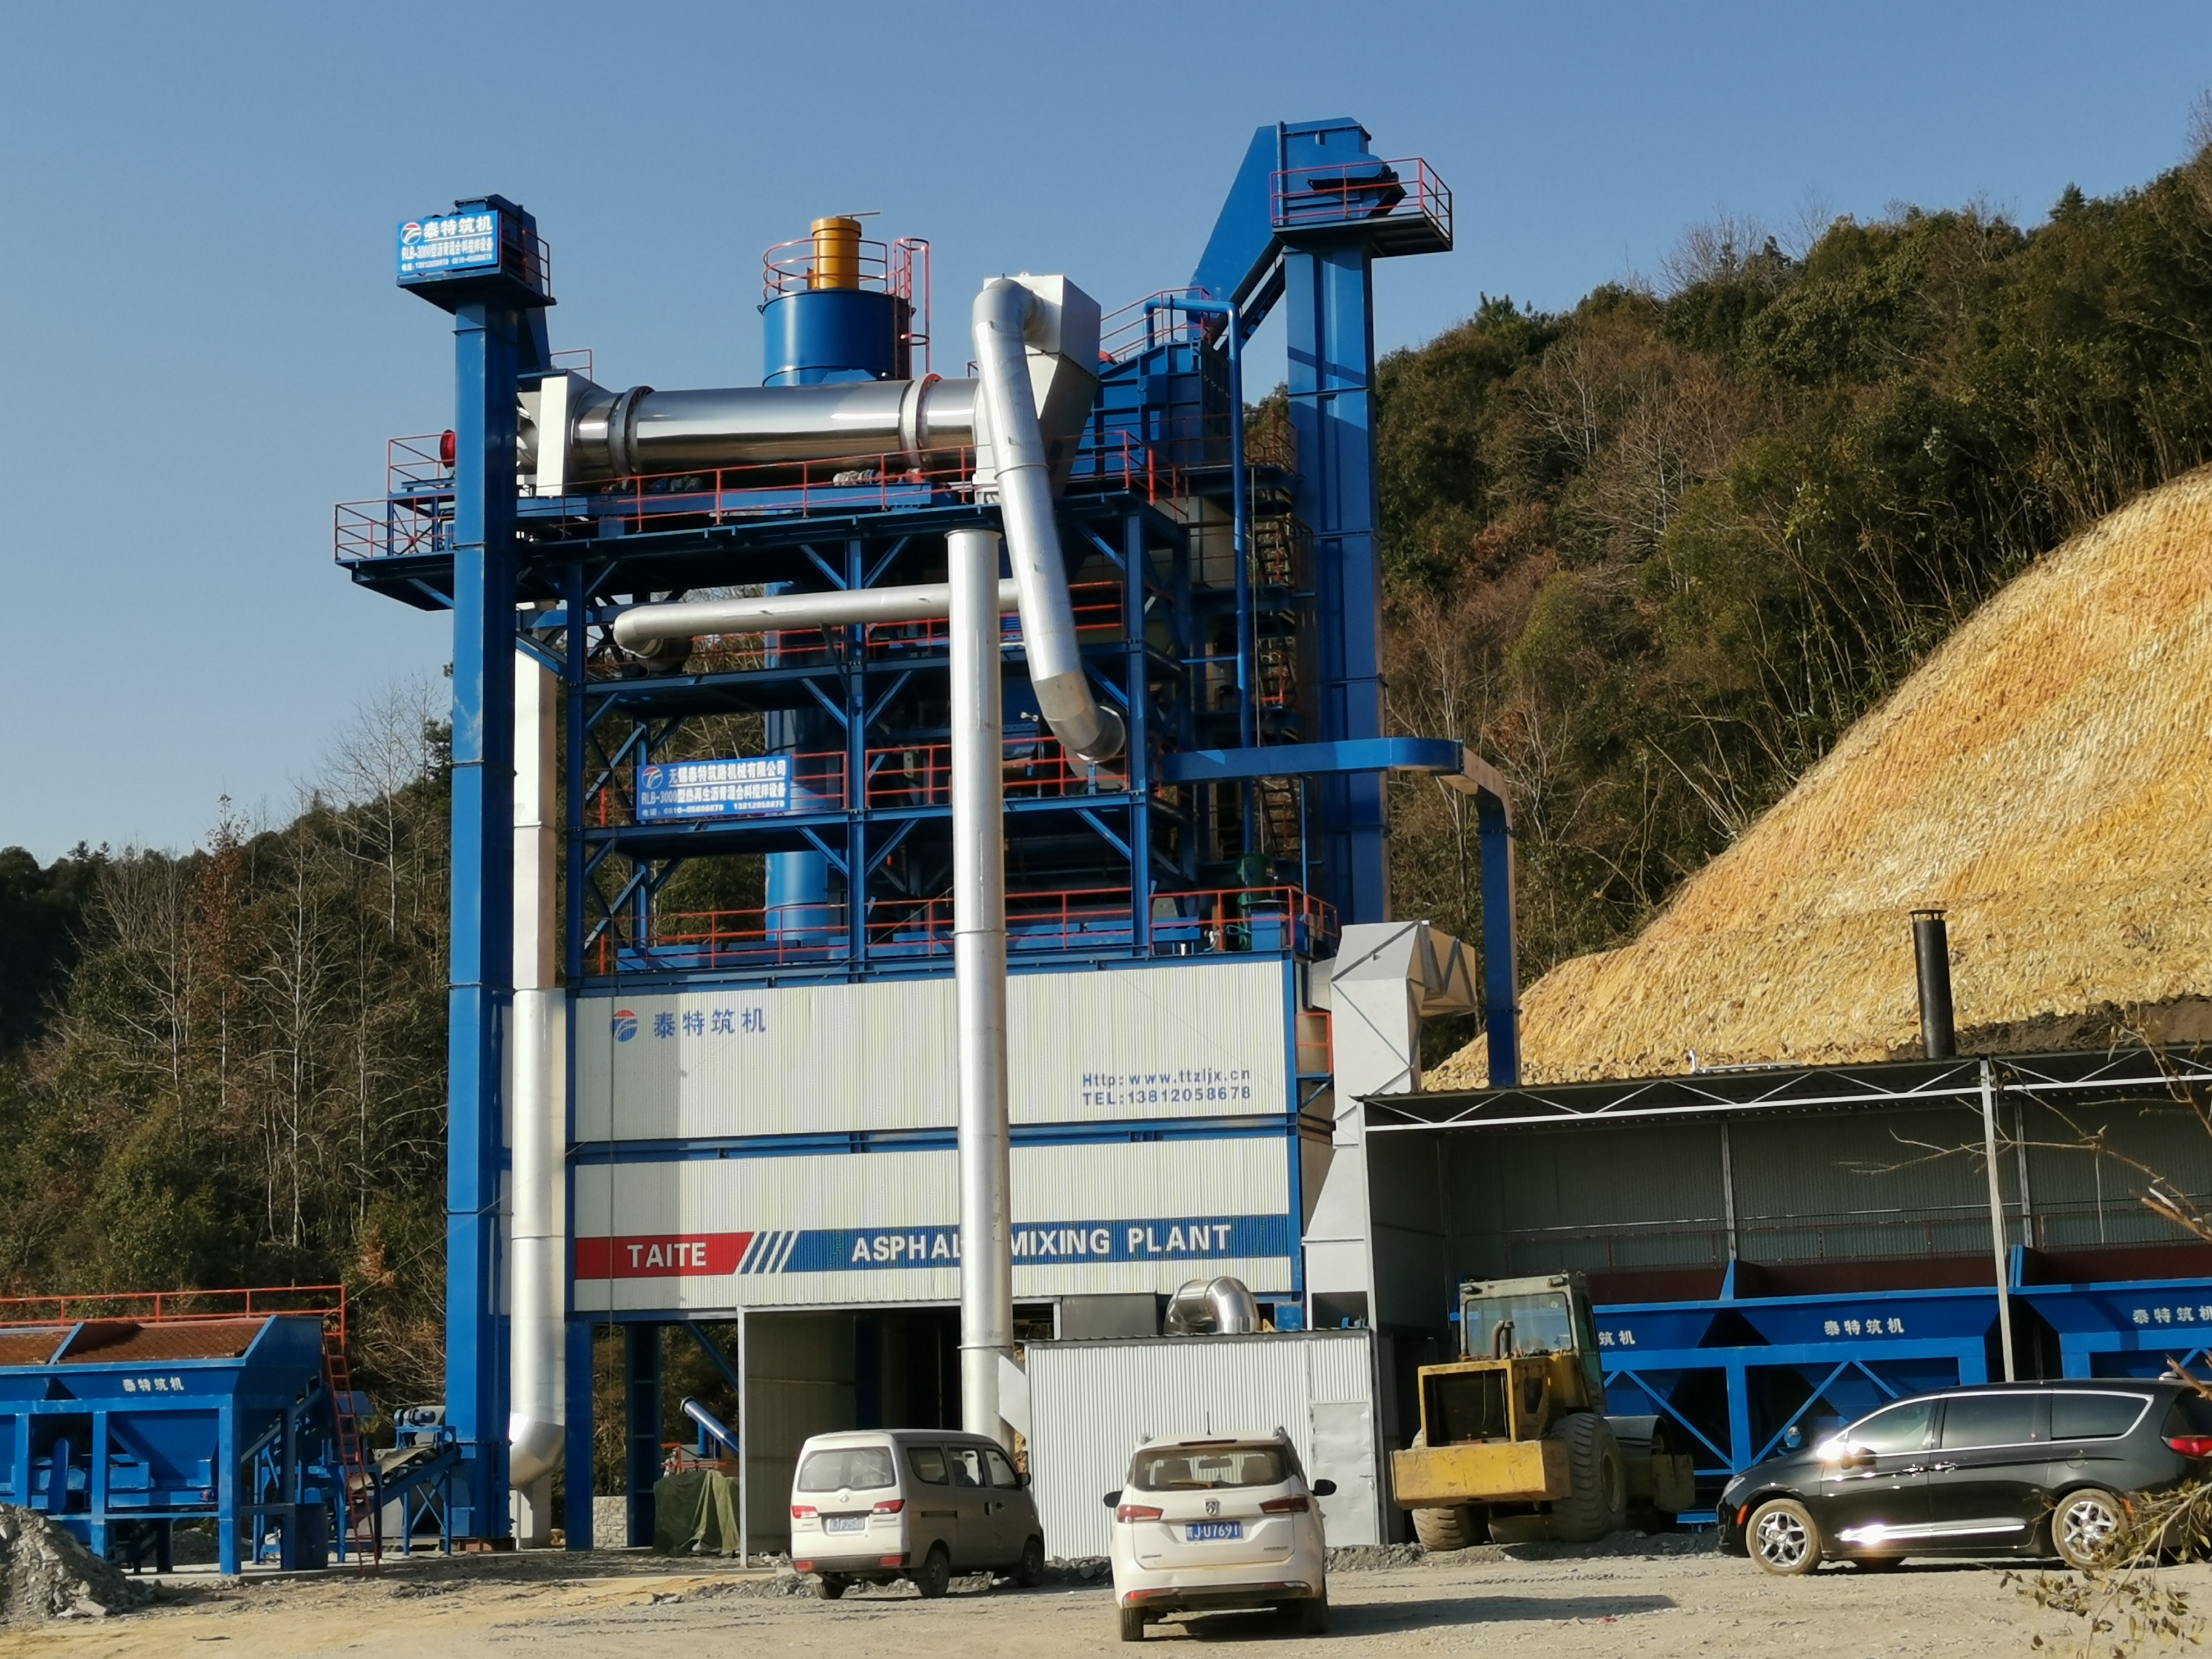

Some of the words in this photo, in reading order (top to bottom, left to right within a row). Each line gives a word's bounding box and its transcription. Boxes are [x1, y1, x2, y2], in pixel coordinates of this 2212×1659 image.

[423, 215, 493, 239] 泰特筑机
[669, 760, 786, 784] 无锡泰特筑路机械有限公司
[653, 1007, 766, 1039] 泰特筑机
[627, 1242, 706, 1268] TAITE
[851, 1233, 960, 1262] ASPHAL
[1011, 1228, 1110, 1257] MIXING
[1128, 1224, 1232, 1254] PLANT
[1824, 1318, 1905, 1336] 泰特筑机
[122, 1376, 184, 1392] 泰特筑机
